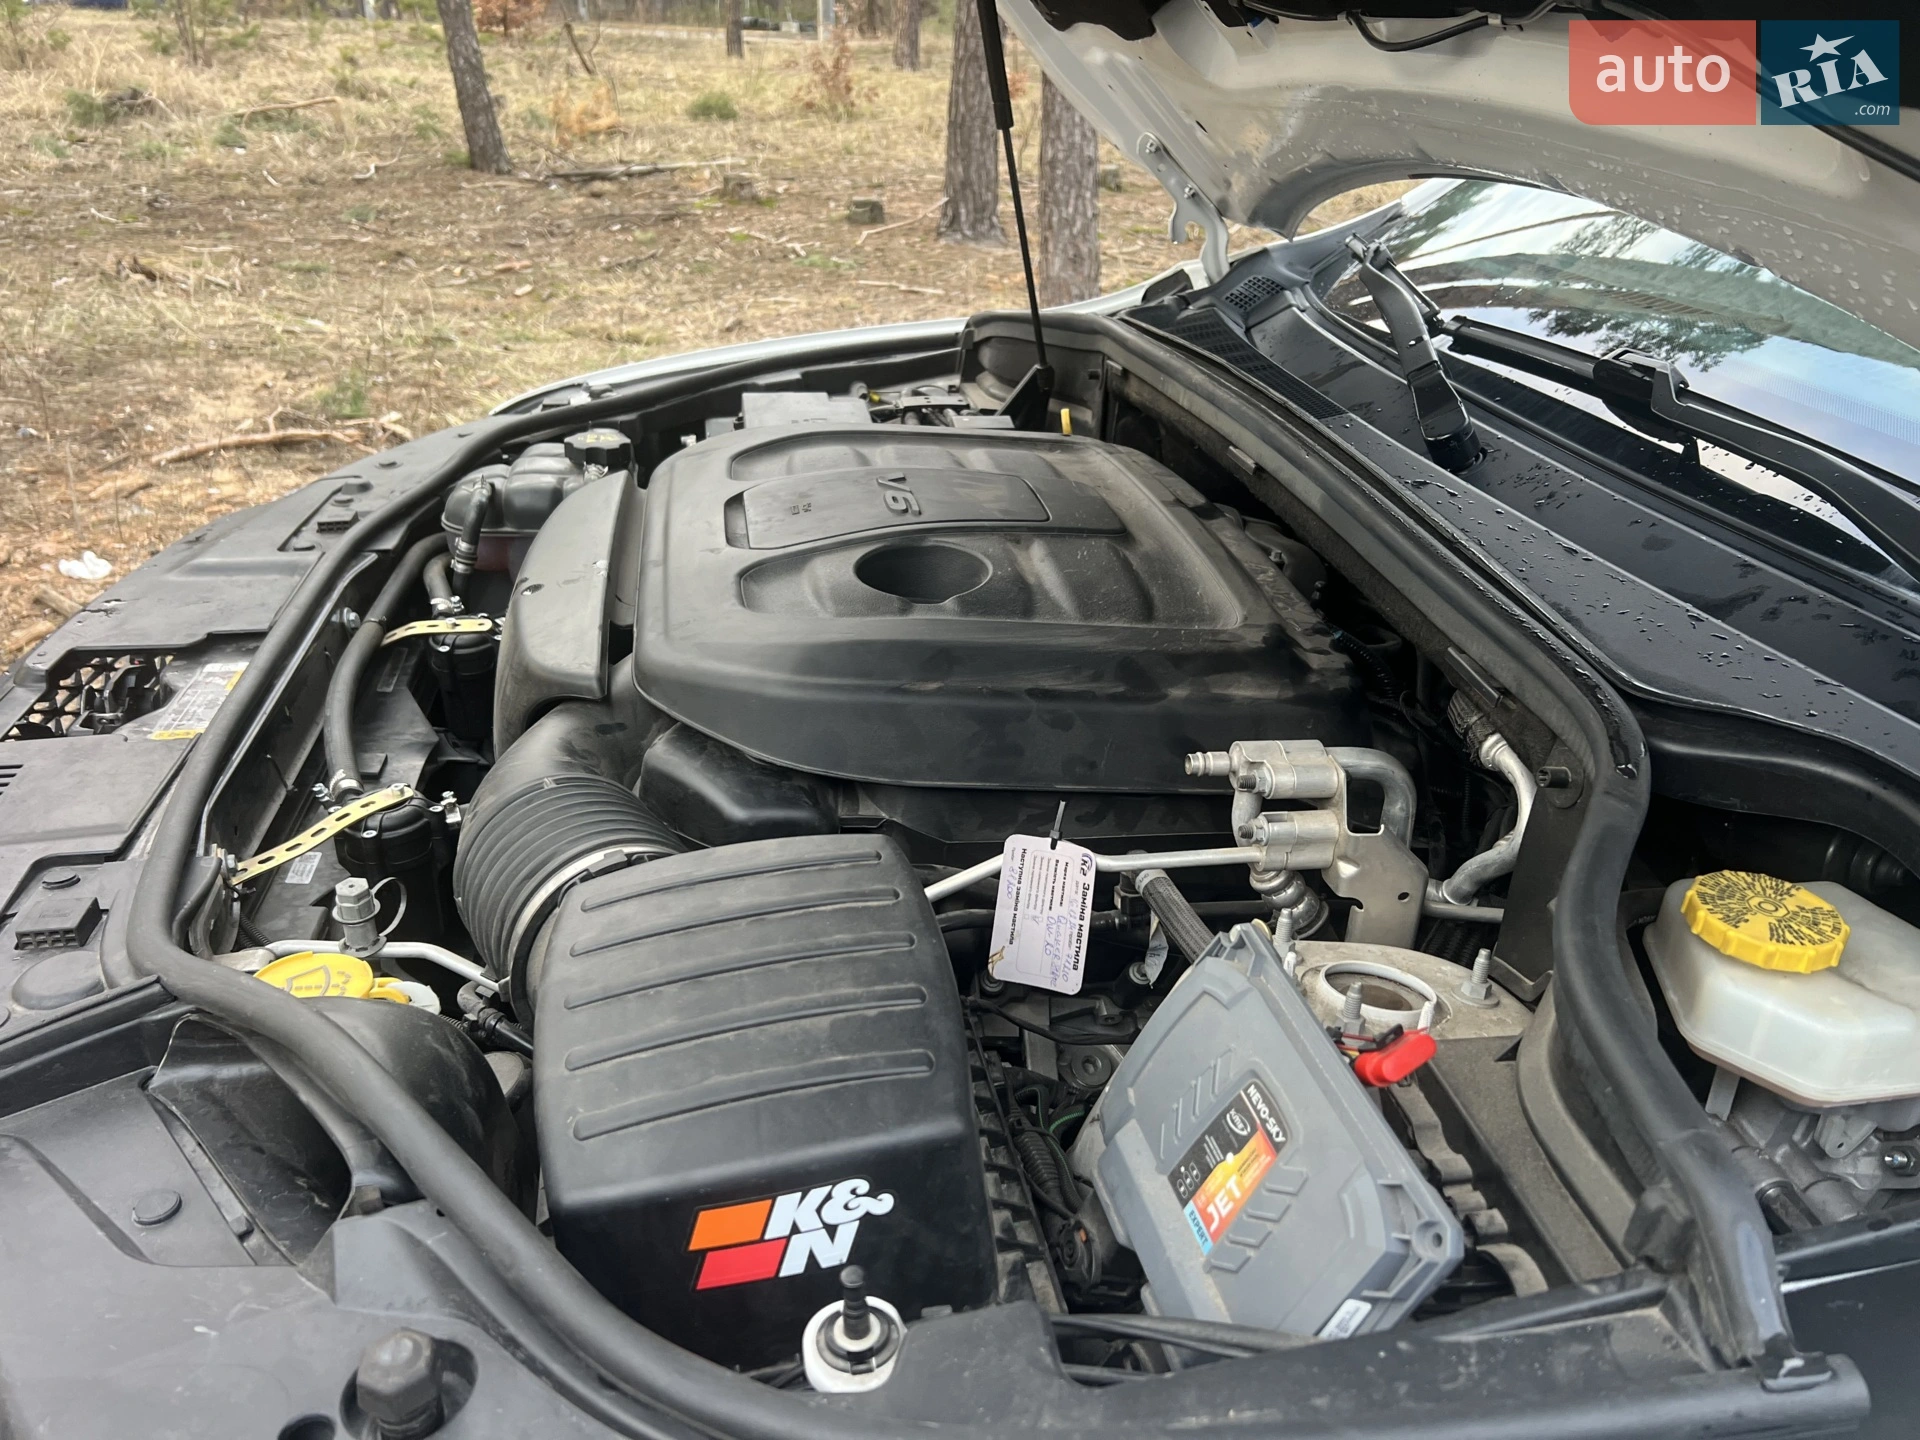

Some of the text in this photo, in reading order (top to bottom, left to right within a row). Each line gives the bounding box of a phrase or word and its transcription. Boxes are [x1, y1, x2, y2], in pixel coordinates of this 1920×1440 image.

[876, 472, 921, 516] V6
[1019, 848, 1027, 884] Наступна
[1079, 859, 1088, 876] K2
[1009, 913, 1017, 945] мастила
[1073, 883, 1090, 971] Заміна мастила
[1247, 1085, 1286, 1143] NEVO-SKY
[1206, 1175, 1242, 1233] JET
[764, 1179, 894, 1278] K&N
[1188, 1210, 1209, 1245] EXPERT
